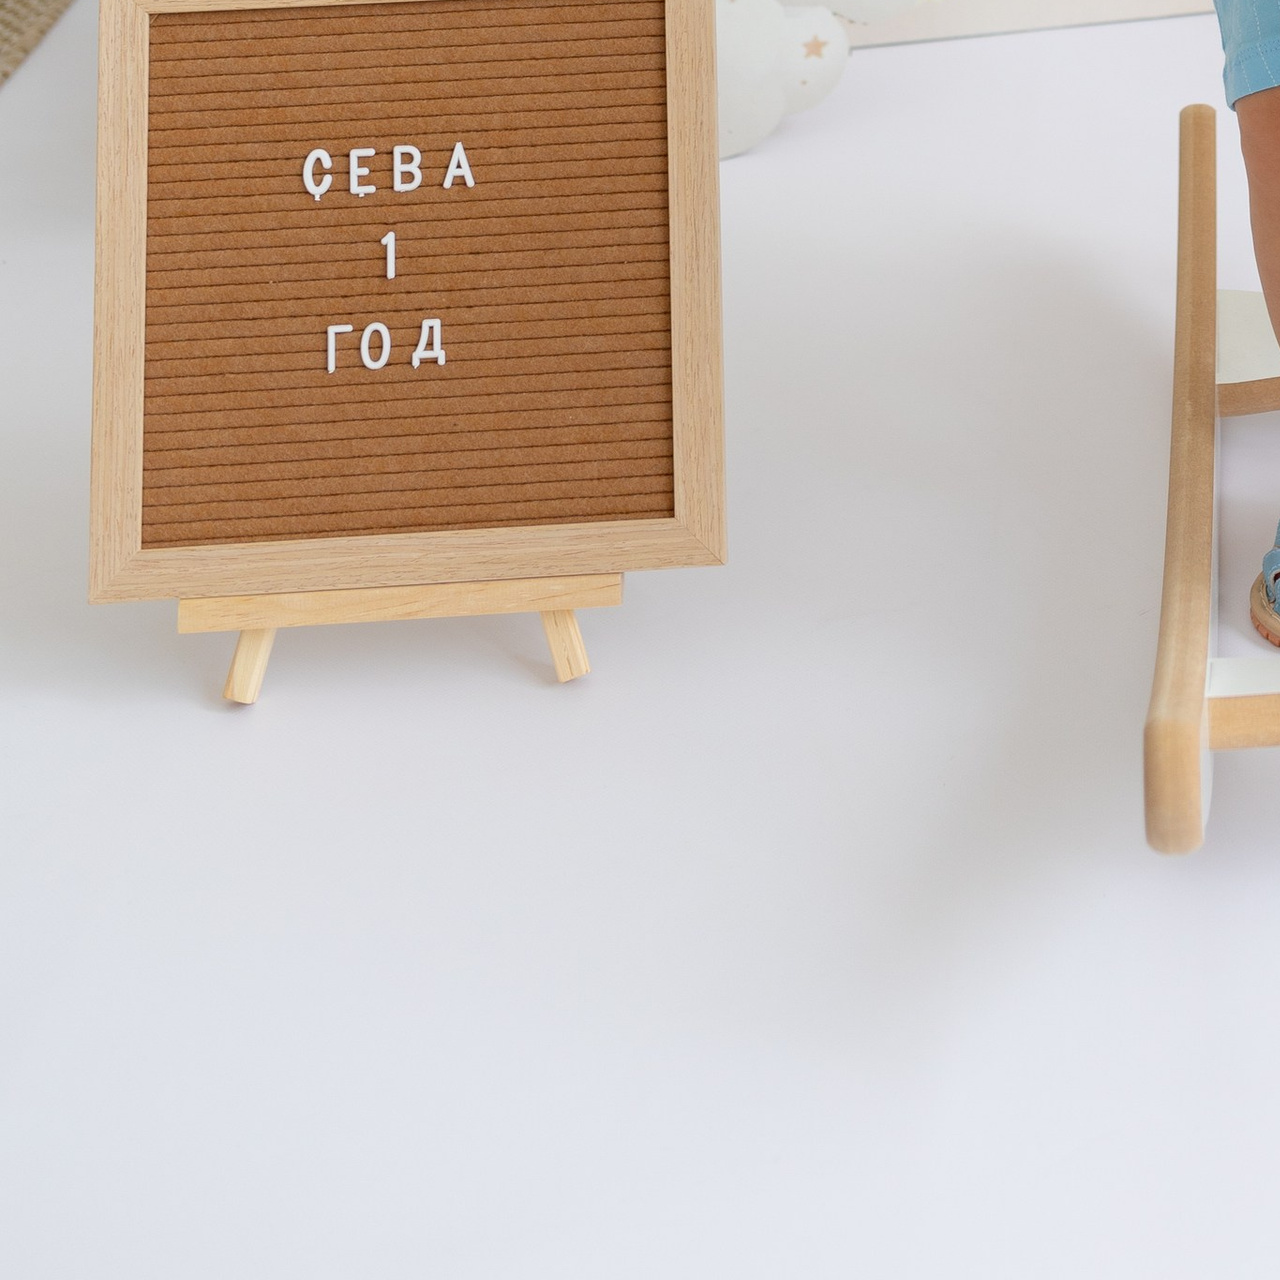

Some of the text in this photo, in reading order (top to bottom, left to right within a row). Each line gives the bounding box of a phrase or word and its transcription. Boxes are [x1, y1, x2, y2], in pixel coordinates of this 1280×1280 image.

[302, 141, 476, 198] СЕВА
[380, 230, 396, 280] 1
[326, 318, 446, 374] ГОД
